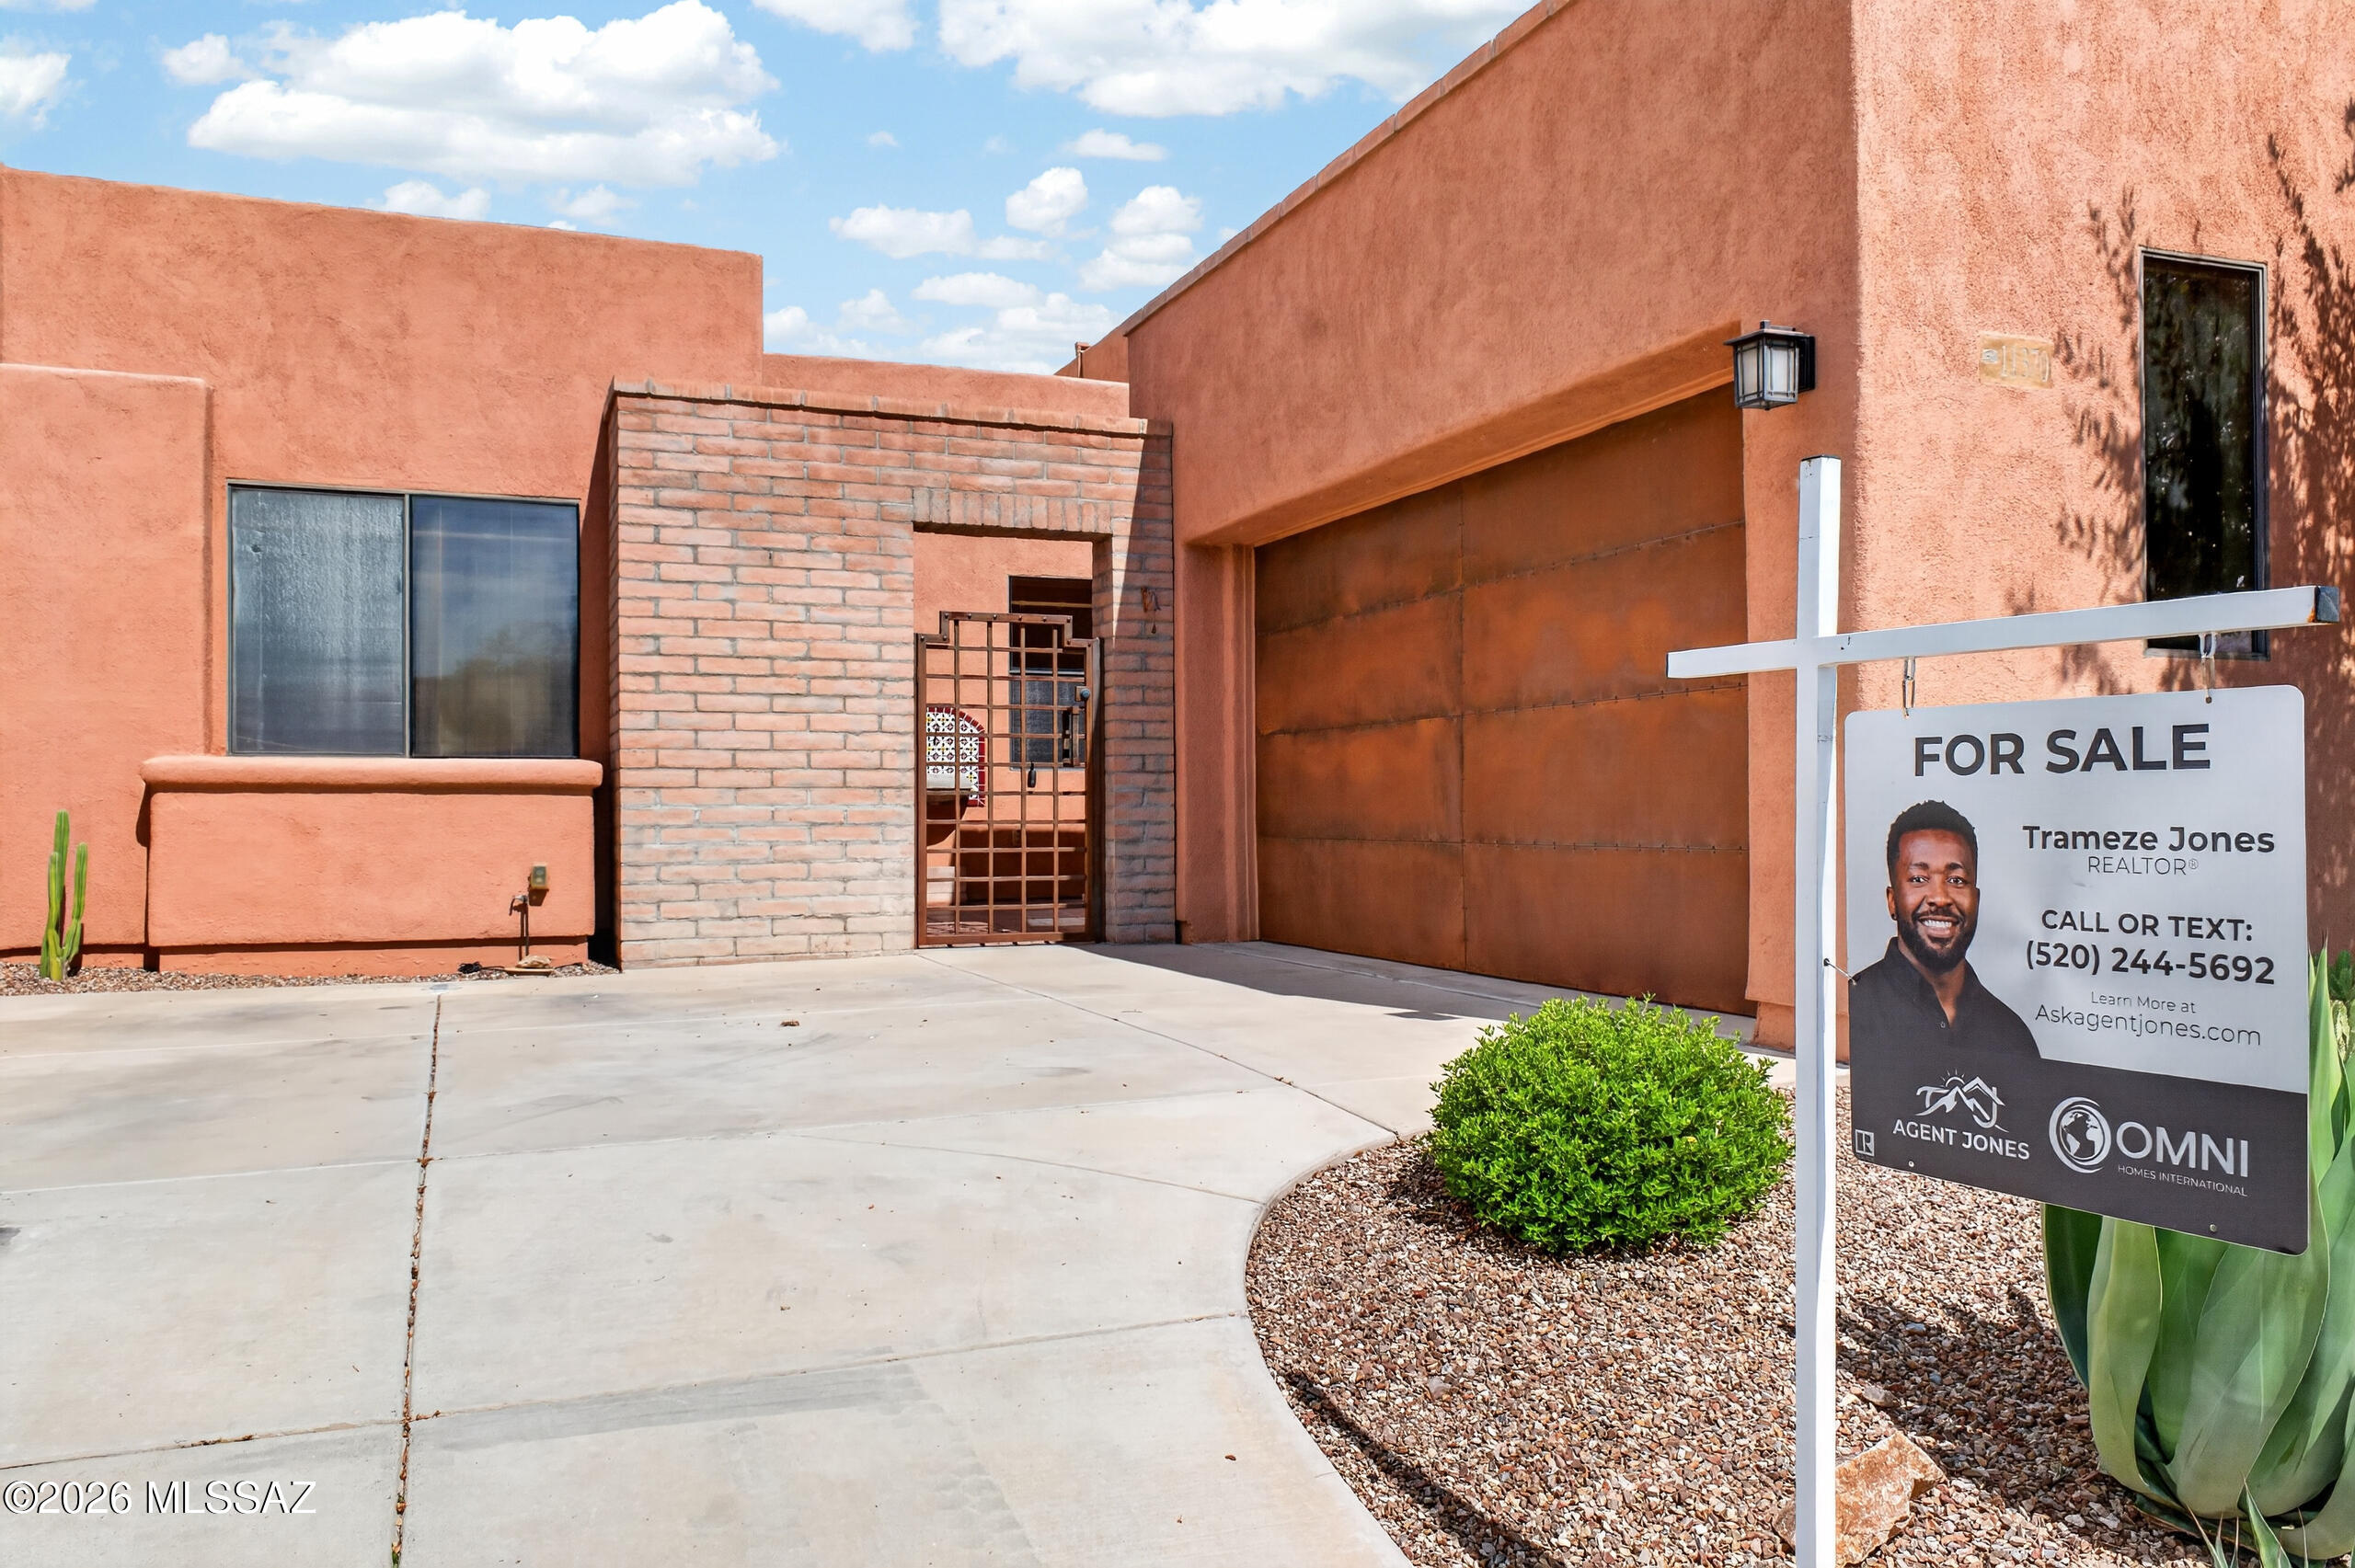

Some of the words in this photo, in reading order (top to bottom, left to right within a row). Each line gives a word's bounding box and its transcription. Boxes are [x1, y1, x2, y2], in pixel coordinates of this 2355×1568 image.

[1914, 732, 2025, 777] FOR
[2045, 723, 2211, 773] SALE
[2023, 825, 2158, 851] Trameze
[2168, 827, 2275, 853] Jones
[2041, 910, 2109, 933] CALL
[2118, 913, 2159, 937] OR
[2168, 915, 2253, 942] TEXT:
[2026, 940, 2100, 976] (520)
[2111, 947, 2275, 985] 244-5692
[2091, 991, 2132, 1007] Learn
[2137, 995, 2177, 1012] More
[2180, 1001, 2197, 1013] at
[2035, 1004, 2261, 1046] Askagentjones.com
[1892, 1118, 1958, 1146] AGENT
[1961, 1131, 2030, 1160] JONES
[2116, 1121, 2248, 1177] OMNI
[2118, 1164, 2156, 1180] HOMES
[2158, 1172, 2248, 1197] INTERNATIONAL
